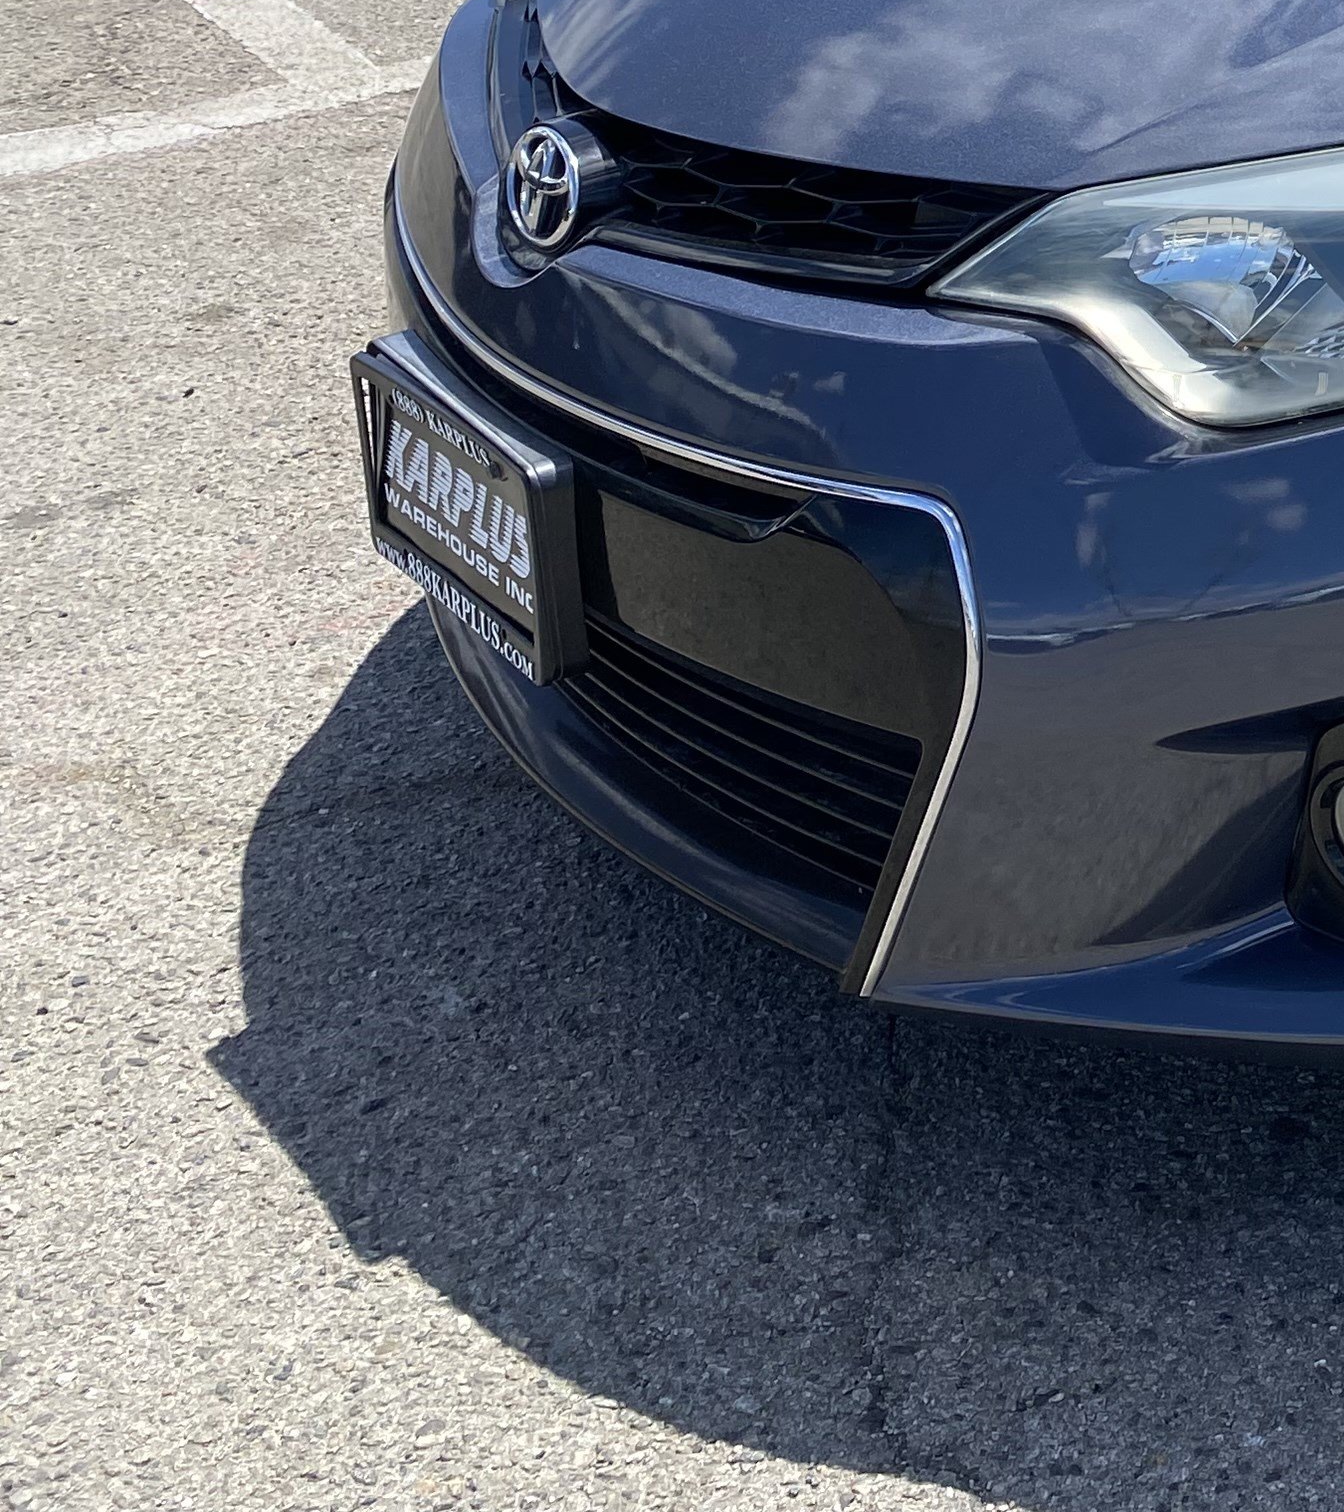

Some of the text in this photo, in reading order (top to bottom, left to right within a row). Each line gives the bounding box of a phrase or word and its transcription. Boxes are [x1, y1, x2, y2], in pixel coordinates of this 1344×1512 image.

[391, 388, 490, 467] (888) KARPLUS
[384, 483, 535, 615] WAREHOUSE INC
[385, 419, 531, 579] KARPLUS
